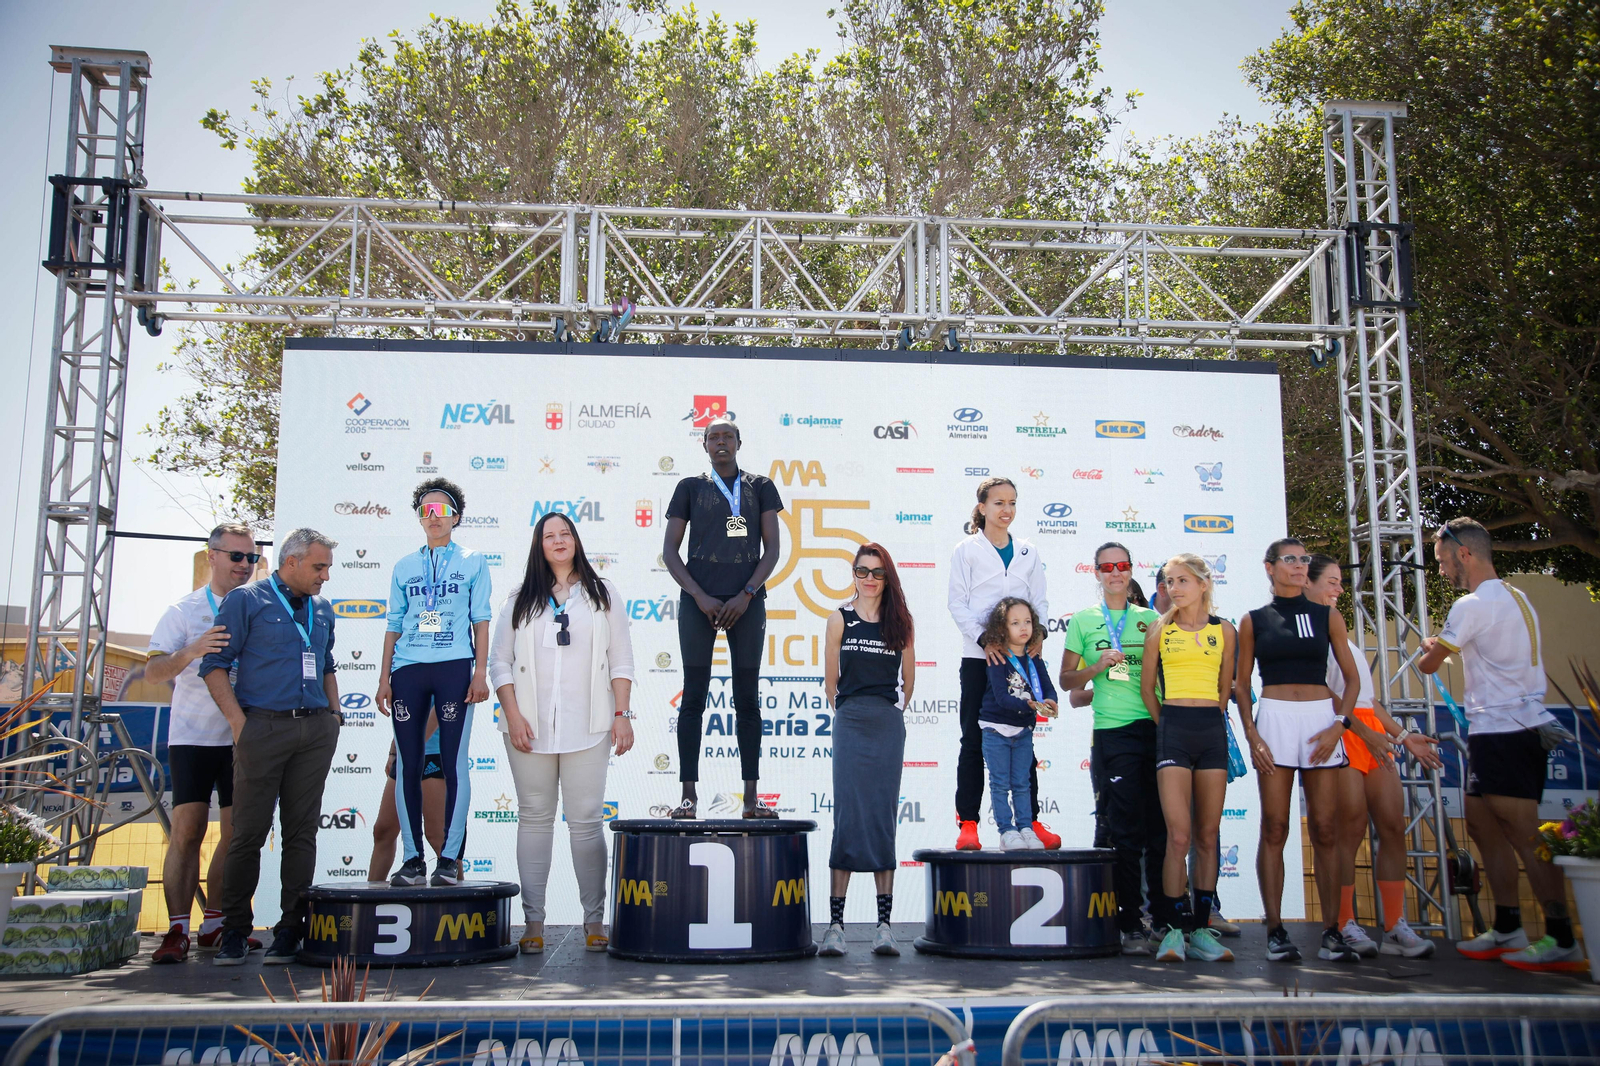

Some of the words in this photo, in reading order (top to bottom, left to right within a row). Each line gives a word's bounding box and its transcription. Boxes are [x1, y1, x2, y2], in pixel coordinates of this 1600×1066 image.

[578, 403, 652, 419] ALMERÍA
[345, 418, 409, 426] COOPERACIÓN
[578, 420, 616, 429] CIUDAD
[797, 415, 843, 428] cajamar
[345, 426, 366, 434] 2005
[873, 426, 909, 439] CASI
[1015, 426, 1067, 434] ESTRELLA
[1102, 425, 1140, 434] IKEA
[949, 432, 988, 440] Almerialva
[346, 463, 385, 472] vellsam
[964, 467, 990, 476] SER
[461, 516, 499, 524] ERACIÓN
[1190, 520, 1228, 528] IKEA
[1105, 521, 1156, 529] ESTRELLA
[341, 560, 380, 569] vellsam
[338, 604, 380, 613] IKEA
[337, 662, 376, 671] vellsam
[904, 700, 958, 714] ALMER
[705, 713, 808, 736] Alería
[770, 747, 806, 758] RUIZ
[332, 765, 372, 774] vellsam
[474, 811, 519, 819] ESTREL
[318, 813, 356, 829] CASI
[326, 868, 367, 877] vellsam
[654, 881, 668, 892] 25
[688, 842, 753, 950] 1
[973, 891, 988, 903] 25
[1009, 867, 1067, 946] 2
[373, 903, 412, 955] 3
